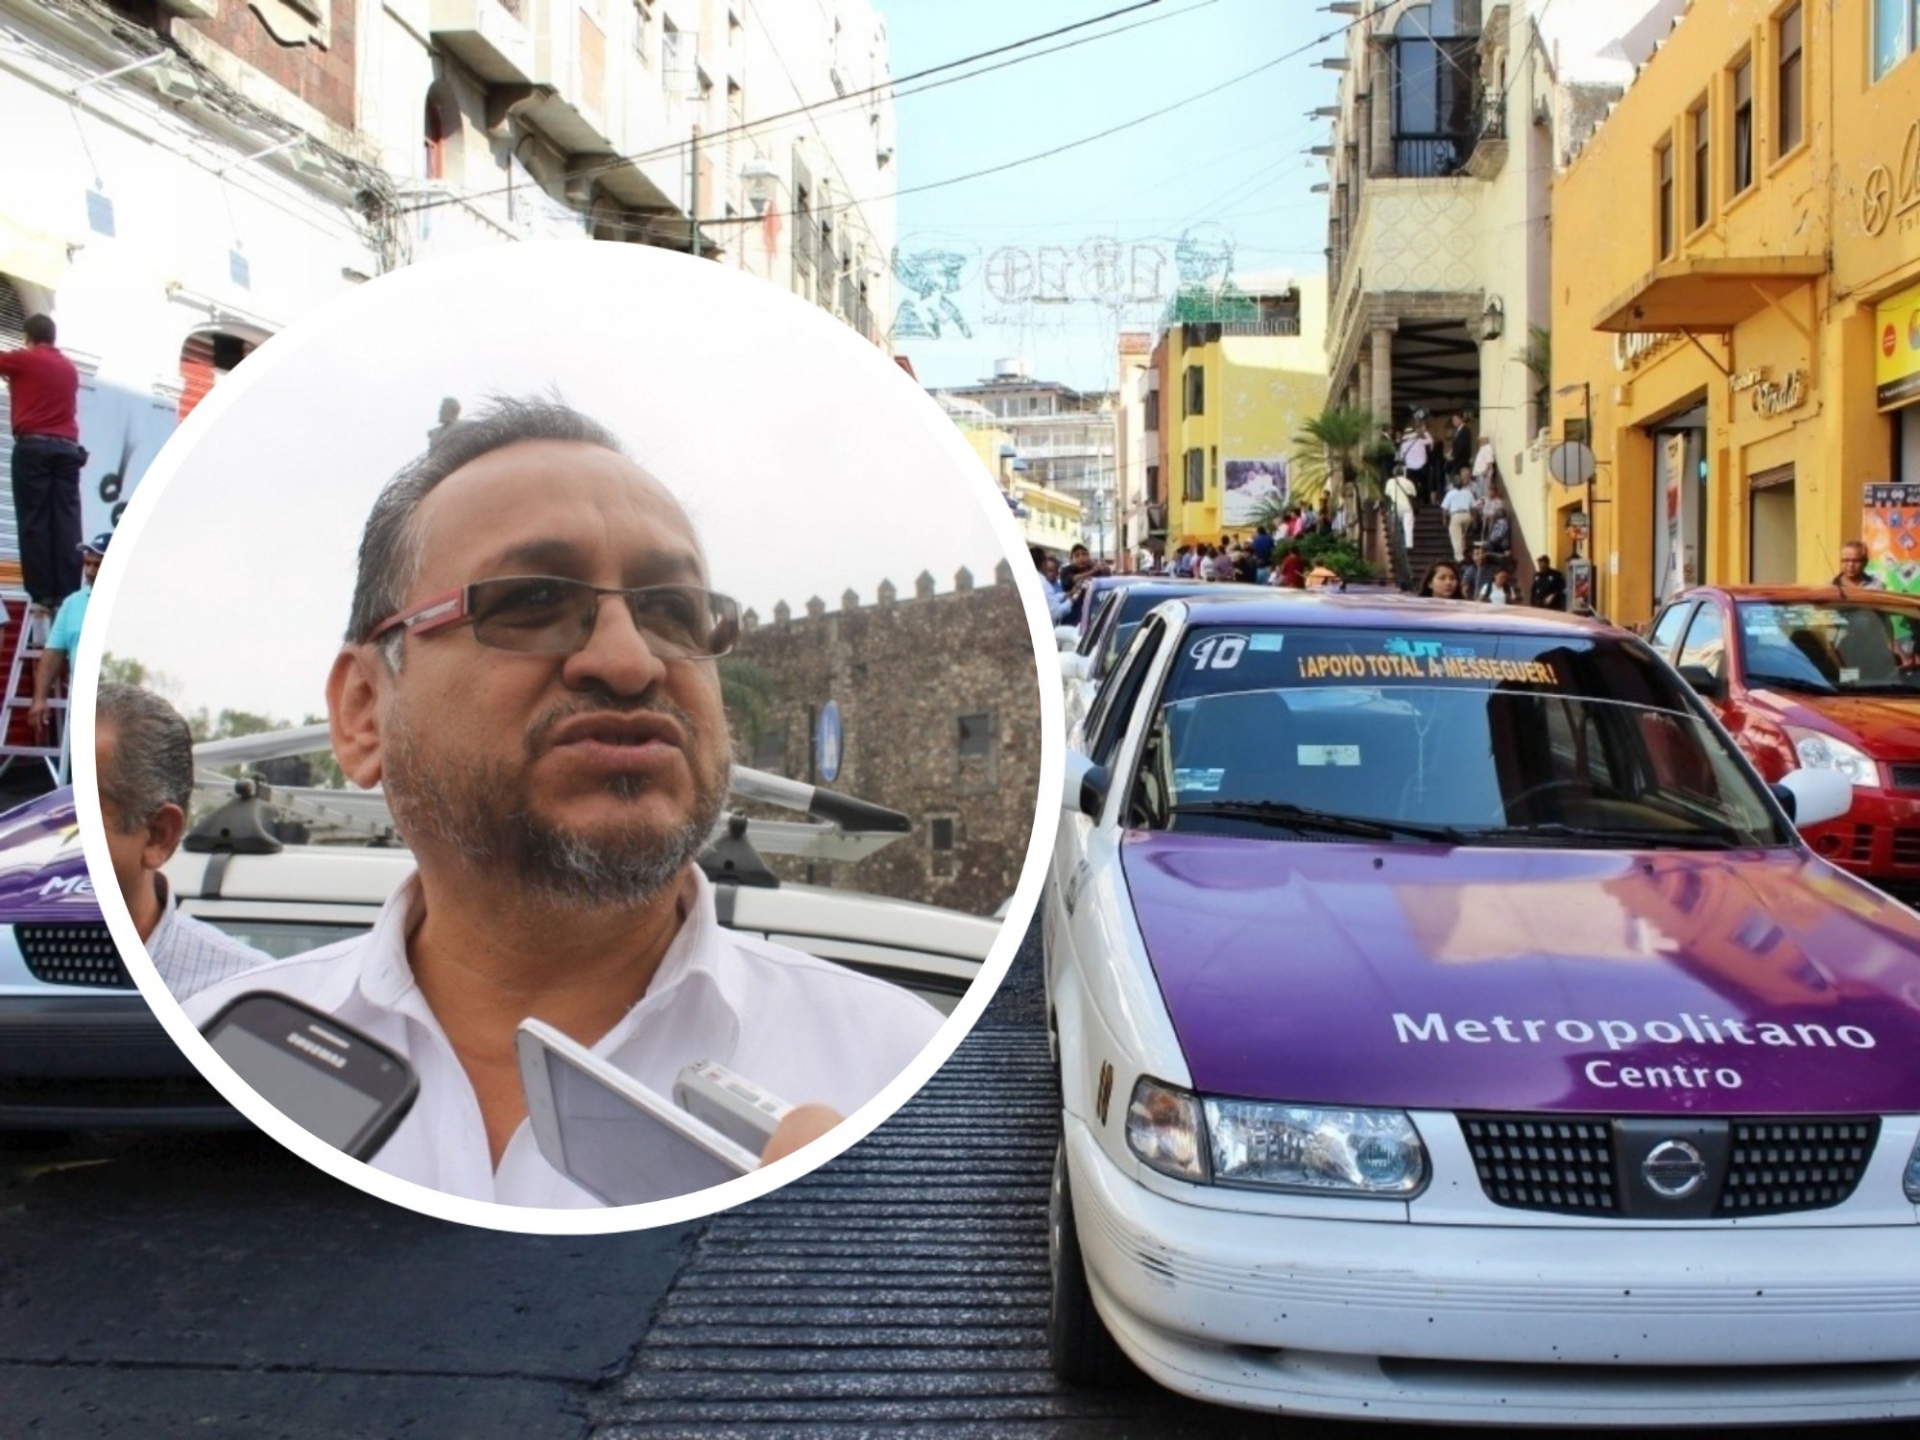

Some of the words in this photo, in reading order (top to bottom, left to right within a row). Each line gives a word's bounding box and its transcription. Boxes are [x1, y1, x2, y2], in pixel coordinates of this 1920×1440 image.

[1297, 654, 1366, 678] ¡APOYO
[1365, 654, 1425, 678] TOTAL
[1428, 656, 1443, 678] A
[1442, 656, 1558, 685] MESSEGUER!
[1391, 1011, 1877, 1050] Metropolitano
[1584, 1059, 1744, 1089] Centro
